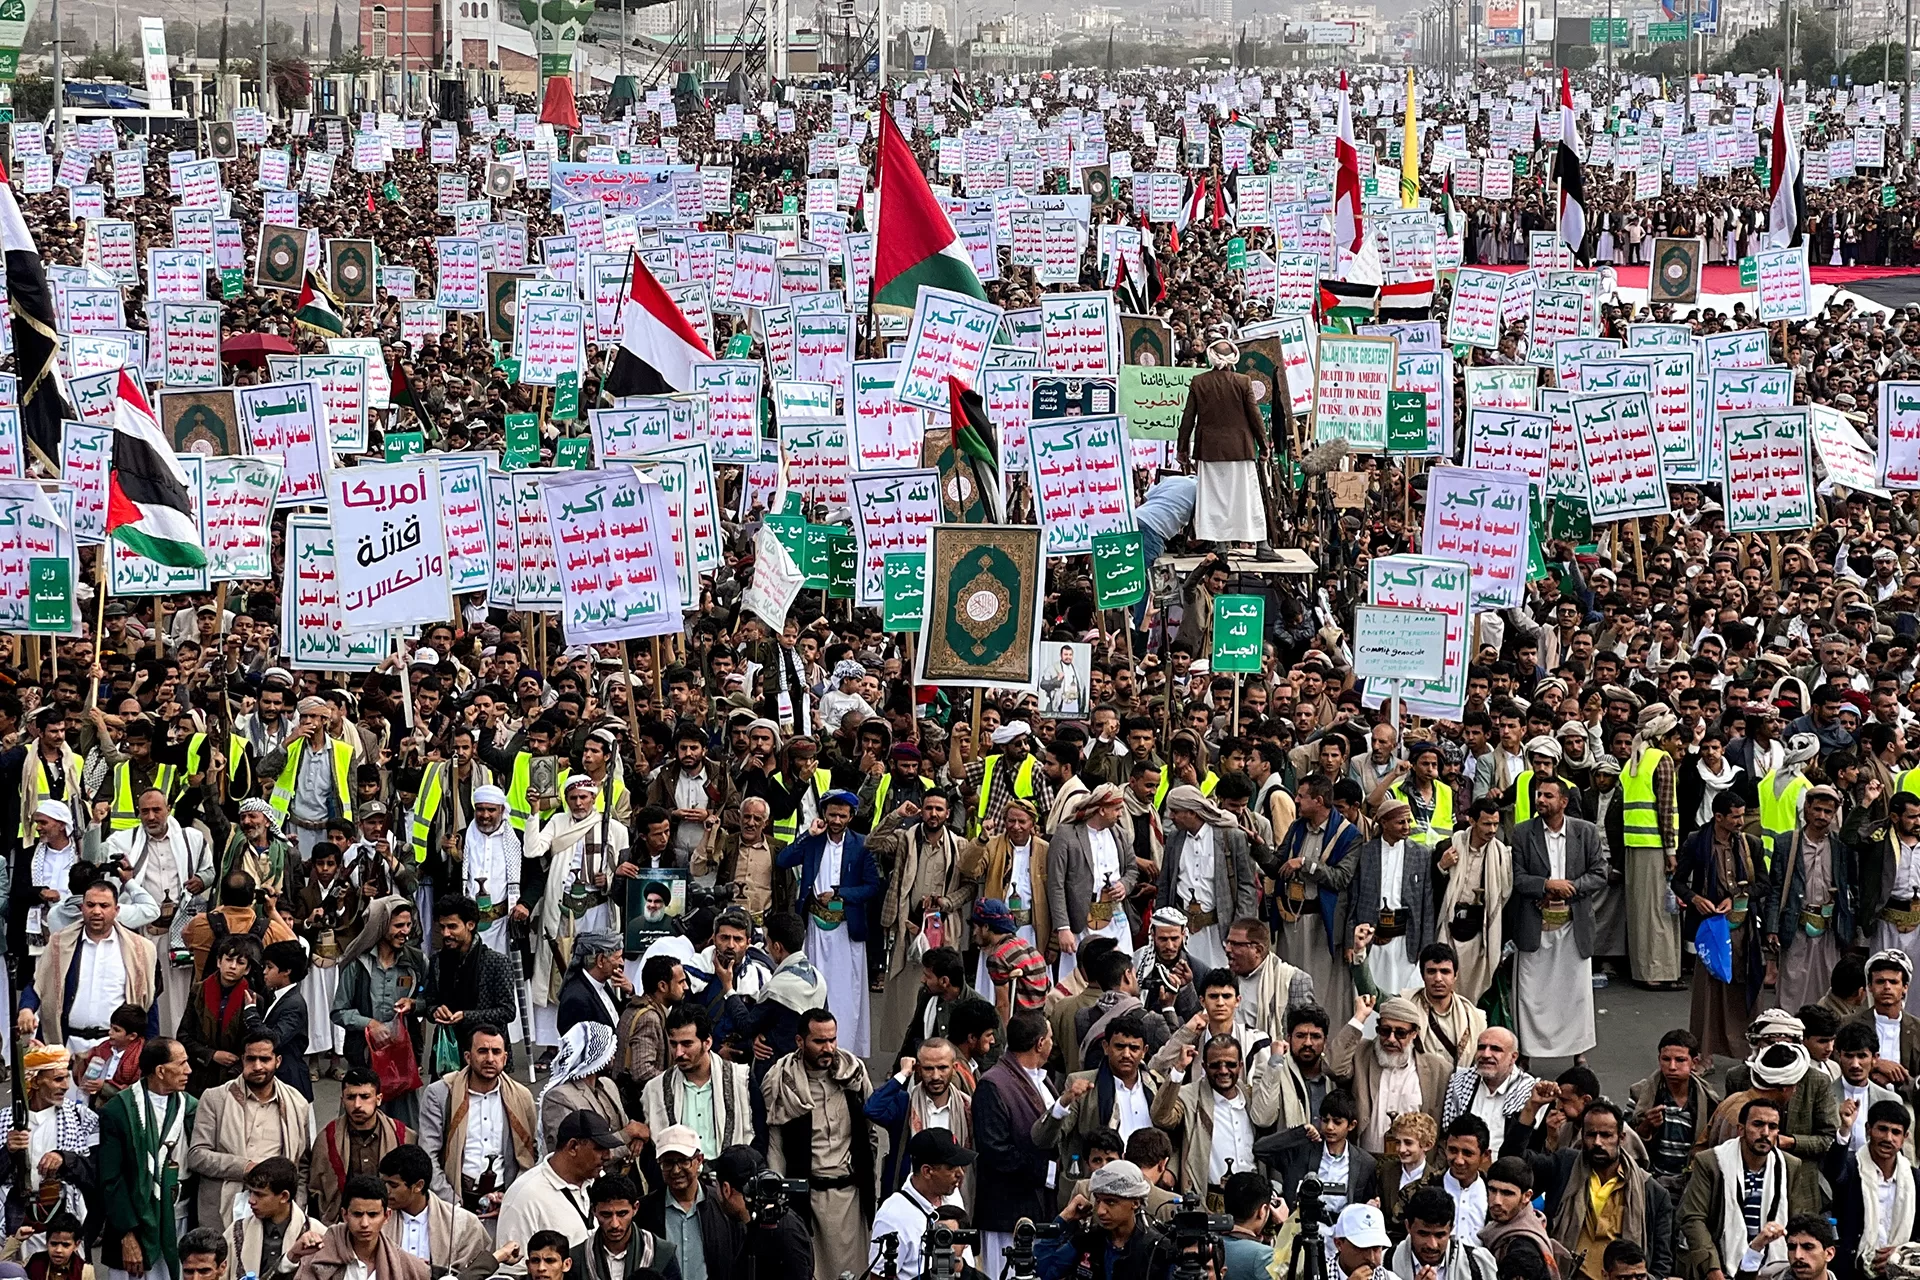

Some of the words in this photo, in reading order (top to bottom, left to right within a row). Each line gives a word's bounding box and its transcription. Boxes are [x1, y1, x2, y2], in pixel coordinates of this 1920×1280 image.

[1341, 347, 1346, 363] IS
[1348, 347, 1358, 363] THE
[1360, 347, 1389, 365] GREATEST
[1320, 370, 1342, 381] DEATH
[1345, 372, 1355, 382] TO
[1357, 372, 1388, 383] AMERICA
[1586, 367, 1621, 392] أكبر
[1623, 370, 1646, 387] الله
[1320, 388, 1342, 398] DEATH
[1345, 389, 1354, 398] TO
[1357, 389, 1381, 400] ISRAEL
[249, 389, 307, 423] قاطعوا
[1349, 405, 1360, 415] ON
[1362, 406, 1382, 417] JEWS
[1582, 399, 1617, 430] أكبر
[1622, 399, 1645, 419] الله
[252, 424, 284, 451] الأمريكية
[286, 424, 313, 448] البضائع
[1087, 427, 1116, 447] الله
[1348, 422, 1361, 440] FOR
[1363, 422, 1383, 441] ISLAM
[1474, 417, 1520, 441] أكبر
[1521, 422, 1550, 440] الله
[1584, 426, 1619, 446] لأمريكا
[1622, 425, 1650, 441] الموت
[1730, 418, 1772, 447] أكبر
[1775, 421, 1802, 439] الله
[1038, 425, 1083, 458] أكبر
[1086, 454, 1119, 468] الموت
[1588, 449, 1622, 467] لإسرائيل
[1625, 444, 1654, 461] الموت
[1730, 444, 1768, 462] لأمريكا
[1771, 446, 1803, 459] الموت
[1039, 456, 1081, 476] لأمريكا
[1619, 468, 1632, 484] على
[1636, 464, 1657, 478] اللعنة
[1731, 466, 1769, 483] لإسرائيل
[1772, 464, 1804, 479] الموت
[1088, 478, 1121, 494] الموت
[1592, 470, 1616, 487] اليهود
[342, 468, 427, 512] أمريكا
[612, 484, 645, 509] الله
[862, 479, 904, 510] أكبر
[908, 481, 936, 501] الله
[1043, 480, 1085, 501] لإسرائيل
[1440, 485, 1491, 510] أكبر
[1492, 488, 1523, 512] الله
[1595, 486, 1626, 510] للإسلام
[1632, 482, 1659, 504] النصر
[1732, 486, 1758, 502] اليهود
[1763, 485, 1777, 501] على
[1781, 483, 1805, 497] اللعنة
[557, 484, 606, 522] أكبر
[1046, 502, 1076, 521] اليهود
[1079, 502, 1095, 519] على
[1099, 499, 1124, 514] اللعنة
[1774, 501, 1806, 523] النصر
[1733, 504, 1770, 526] للإسلام
[560, 519, 606, 544] لأمريكا
[610, 517, 648, 538] الموت
[1049, 523, 1088, 548] للإسلام
[566, 547, 610, 571] لإسرائيل
[614, 542, 653, 563] الموت
[1096, 544, 1121, 558] غزة
[1125, 542, 1139, 558] مع
[627, 566, 657, 584] اللعنة
[1107, 564, 1134, 579] حتى
[1377, 563, 1430, 592] أكبر
[1431, 567, 1465, 591] الله
[345, 554, 443, 611] وانكسرت
[571, 574, 601, 595] اليهود
[605, 572, 623, 592] على
[1101, 581, 1141, 601] النصر
[573, 598, 616, 628] للإسلام
[624, 591, 662, 622] النصر
